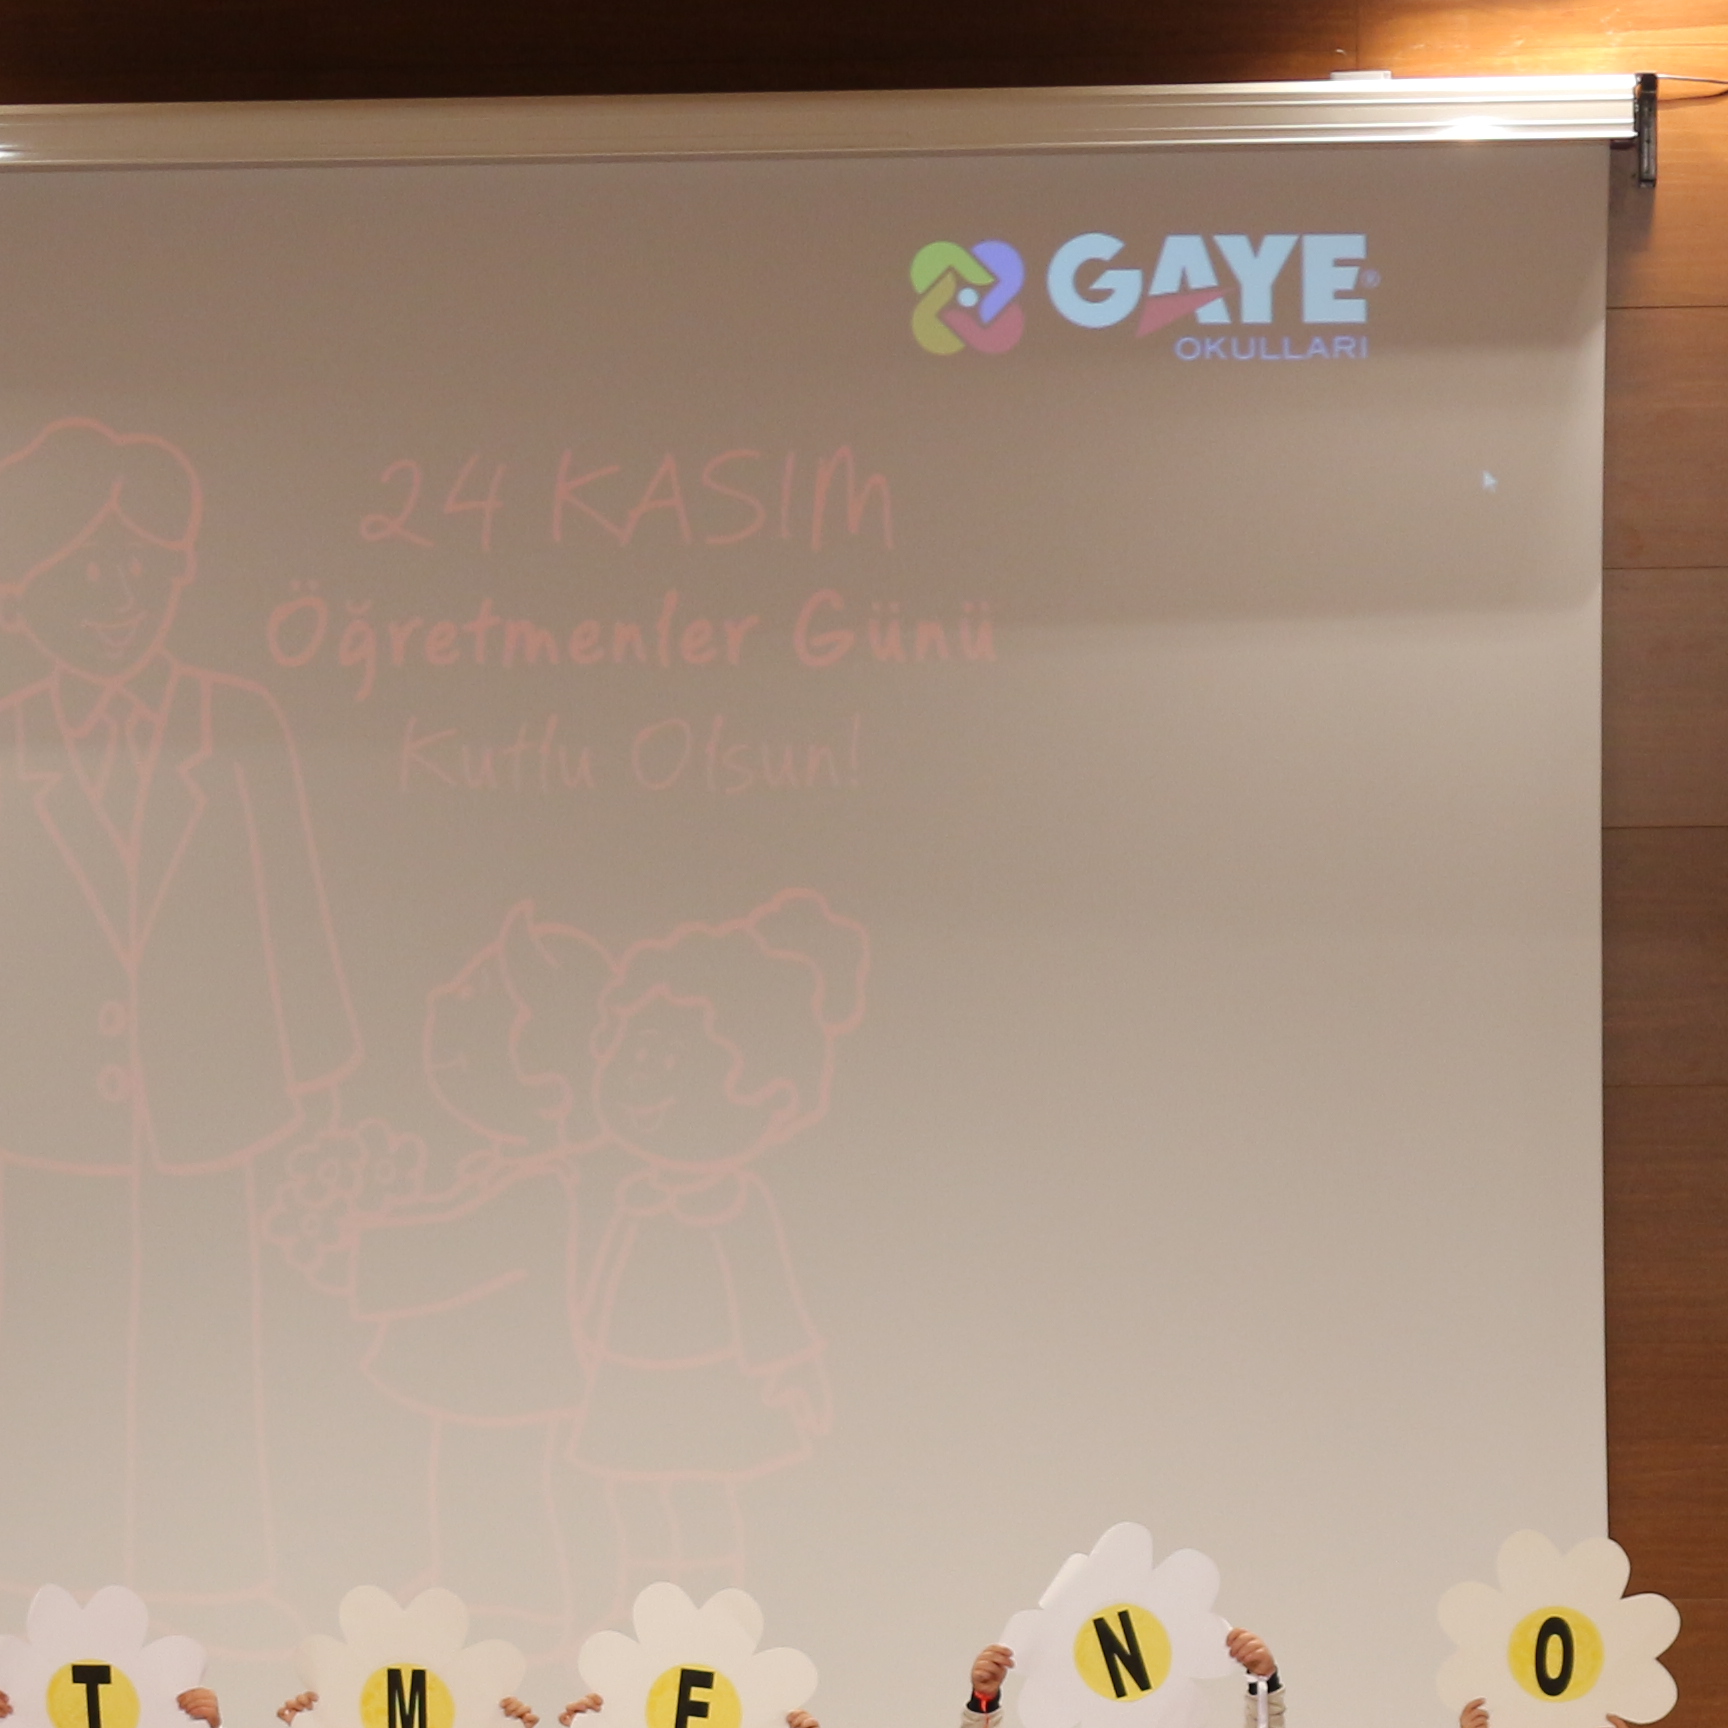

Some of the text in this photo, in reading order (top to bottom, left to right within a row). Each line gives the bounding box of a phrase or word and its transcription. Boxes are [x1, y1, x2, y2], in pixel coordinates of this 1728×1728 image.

[1047, 232, 1367, 335] GAYE
[1175, 336, 1368, 361] OKULLARI
[358, 445, 895, 551] 24 KASIM
[269, 579, 997, 701] Öğretmenler Günü
[400, 713, 864, 794] Kutlu Olsun!
